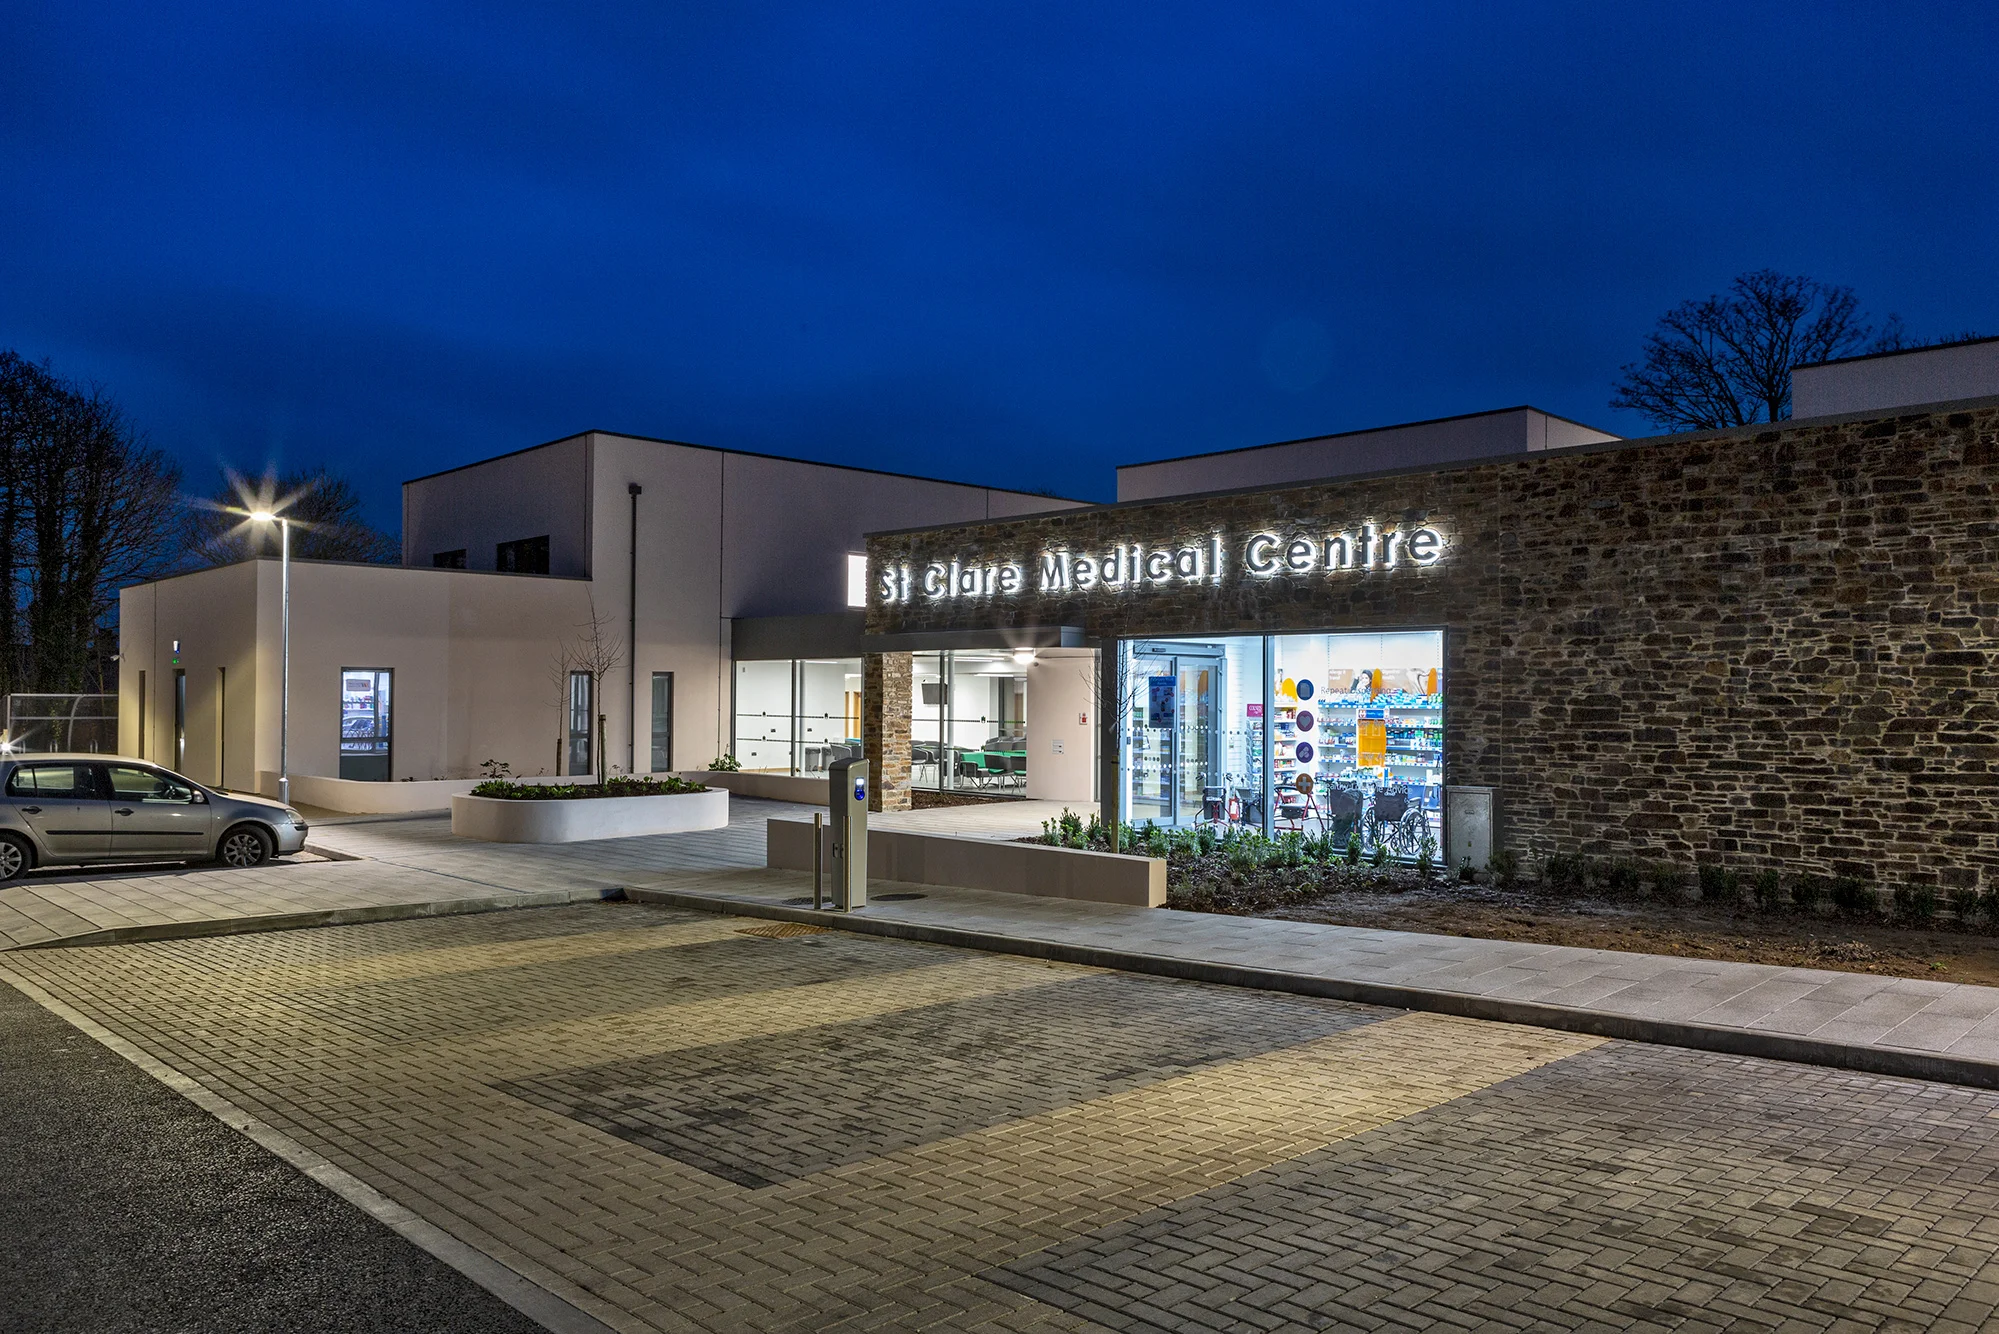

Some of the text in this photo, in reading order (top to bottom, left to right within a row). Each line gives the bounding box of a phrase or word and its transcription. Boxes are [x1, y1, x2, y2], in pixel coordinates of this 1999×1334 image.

[880, 523, 1443, 601] St Clare Medical Centre
[1321, 686, 1348, 695] Repeat
